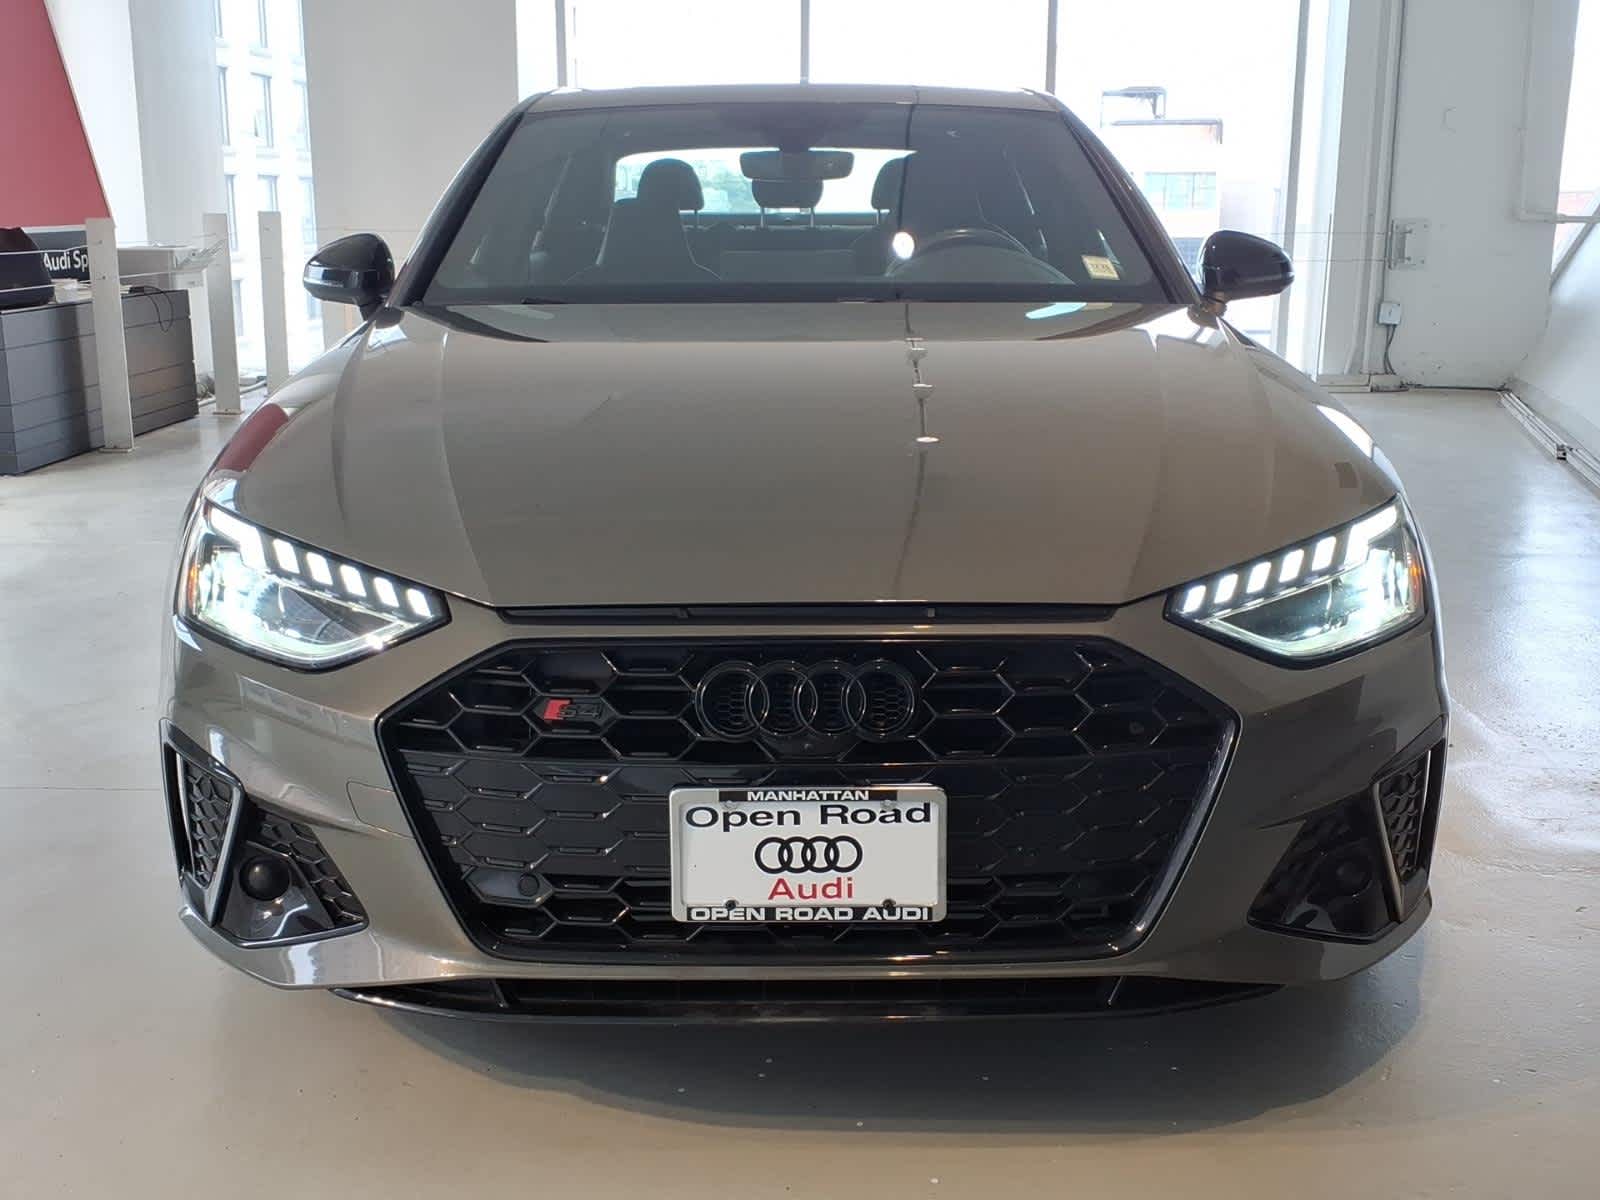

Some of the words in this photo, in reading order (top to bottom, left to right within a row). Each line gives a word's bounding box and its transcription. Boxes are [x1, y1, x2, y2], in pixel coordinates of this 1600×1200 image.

[43, 251, 71, 271] Audi
[747, 790, 870, 801] MANHATTAN
[685, 806, 801, 833] Open
[820, 802, 931, 825] Road
[767, 876, 854, 900] Audi
[690, 906, 766, 921] OPEN
[775, 906, 854, 921] ROAD
[862, 906, 929, 921] AUDI
